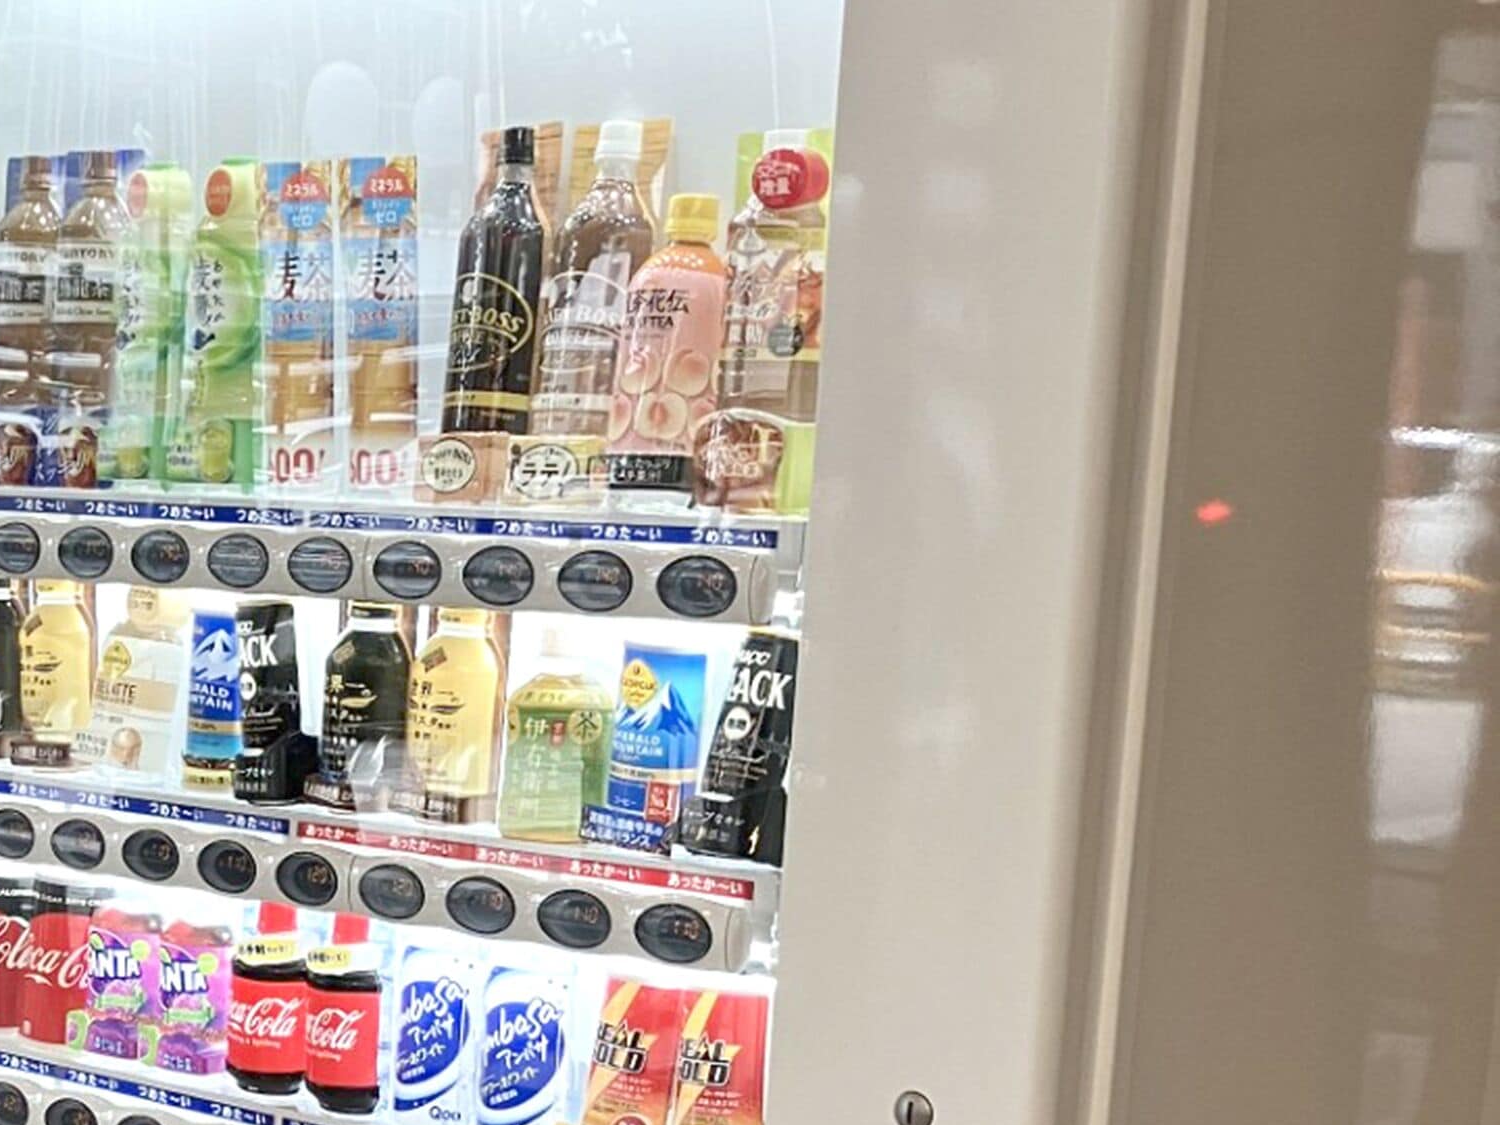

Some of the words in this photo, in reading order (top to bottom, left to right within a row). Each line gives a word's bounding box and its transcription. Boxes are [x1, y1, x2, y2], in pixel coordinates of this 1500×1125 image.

[274, 250, 332, 301] 麦茶
[353, 249, 416, 301] 麦茶
[471, 304, 525, 333] BOSS
[90, 948, 141, 979] ANTA
[594, 1043, 648, 1074] OLD
[679, 1058, 732, 1087] OLD
